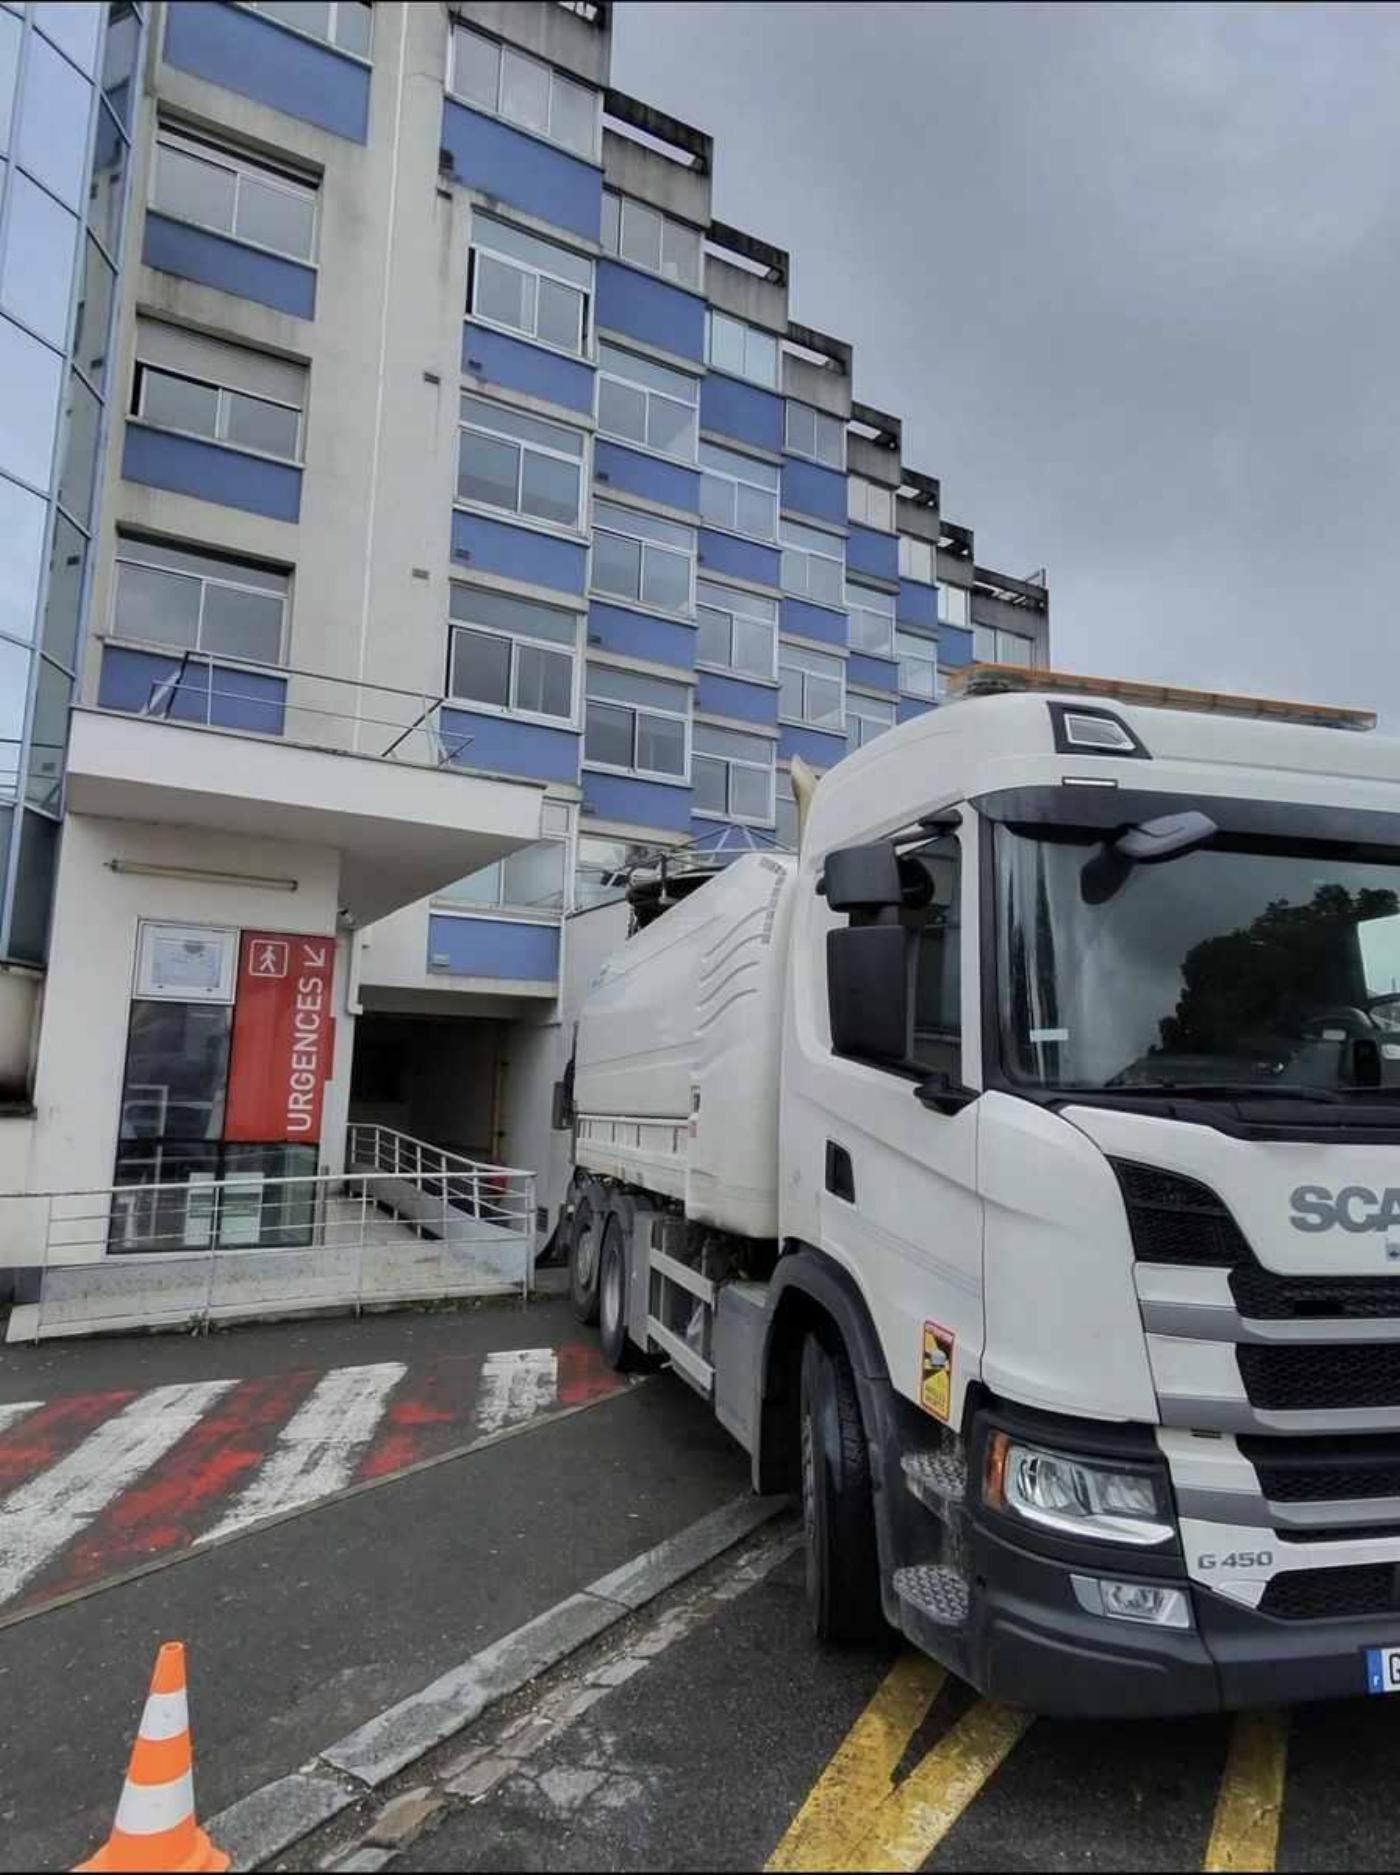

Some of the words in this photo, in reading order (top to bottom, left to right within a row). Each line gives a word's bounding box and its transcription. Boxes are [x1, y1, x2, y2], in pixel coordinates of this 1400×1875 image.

[287, 977, 323, 1131] URGENCES
[1198, 1554, 1216, 1569] G
[1221, 1551, 1273, 1568] 450
